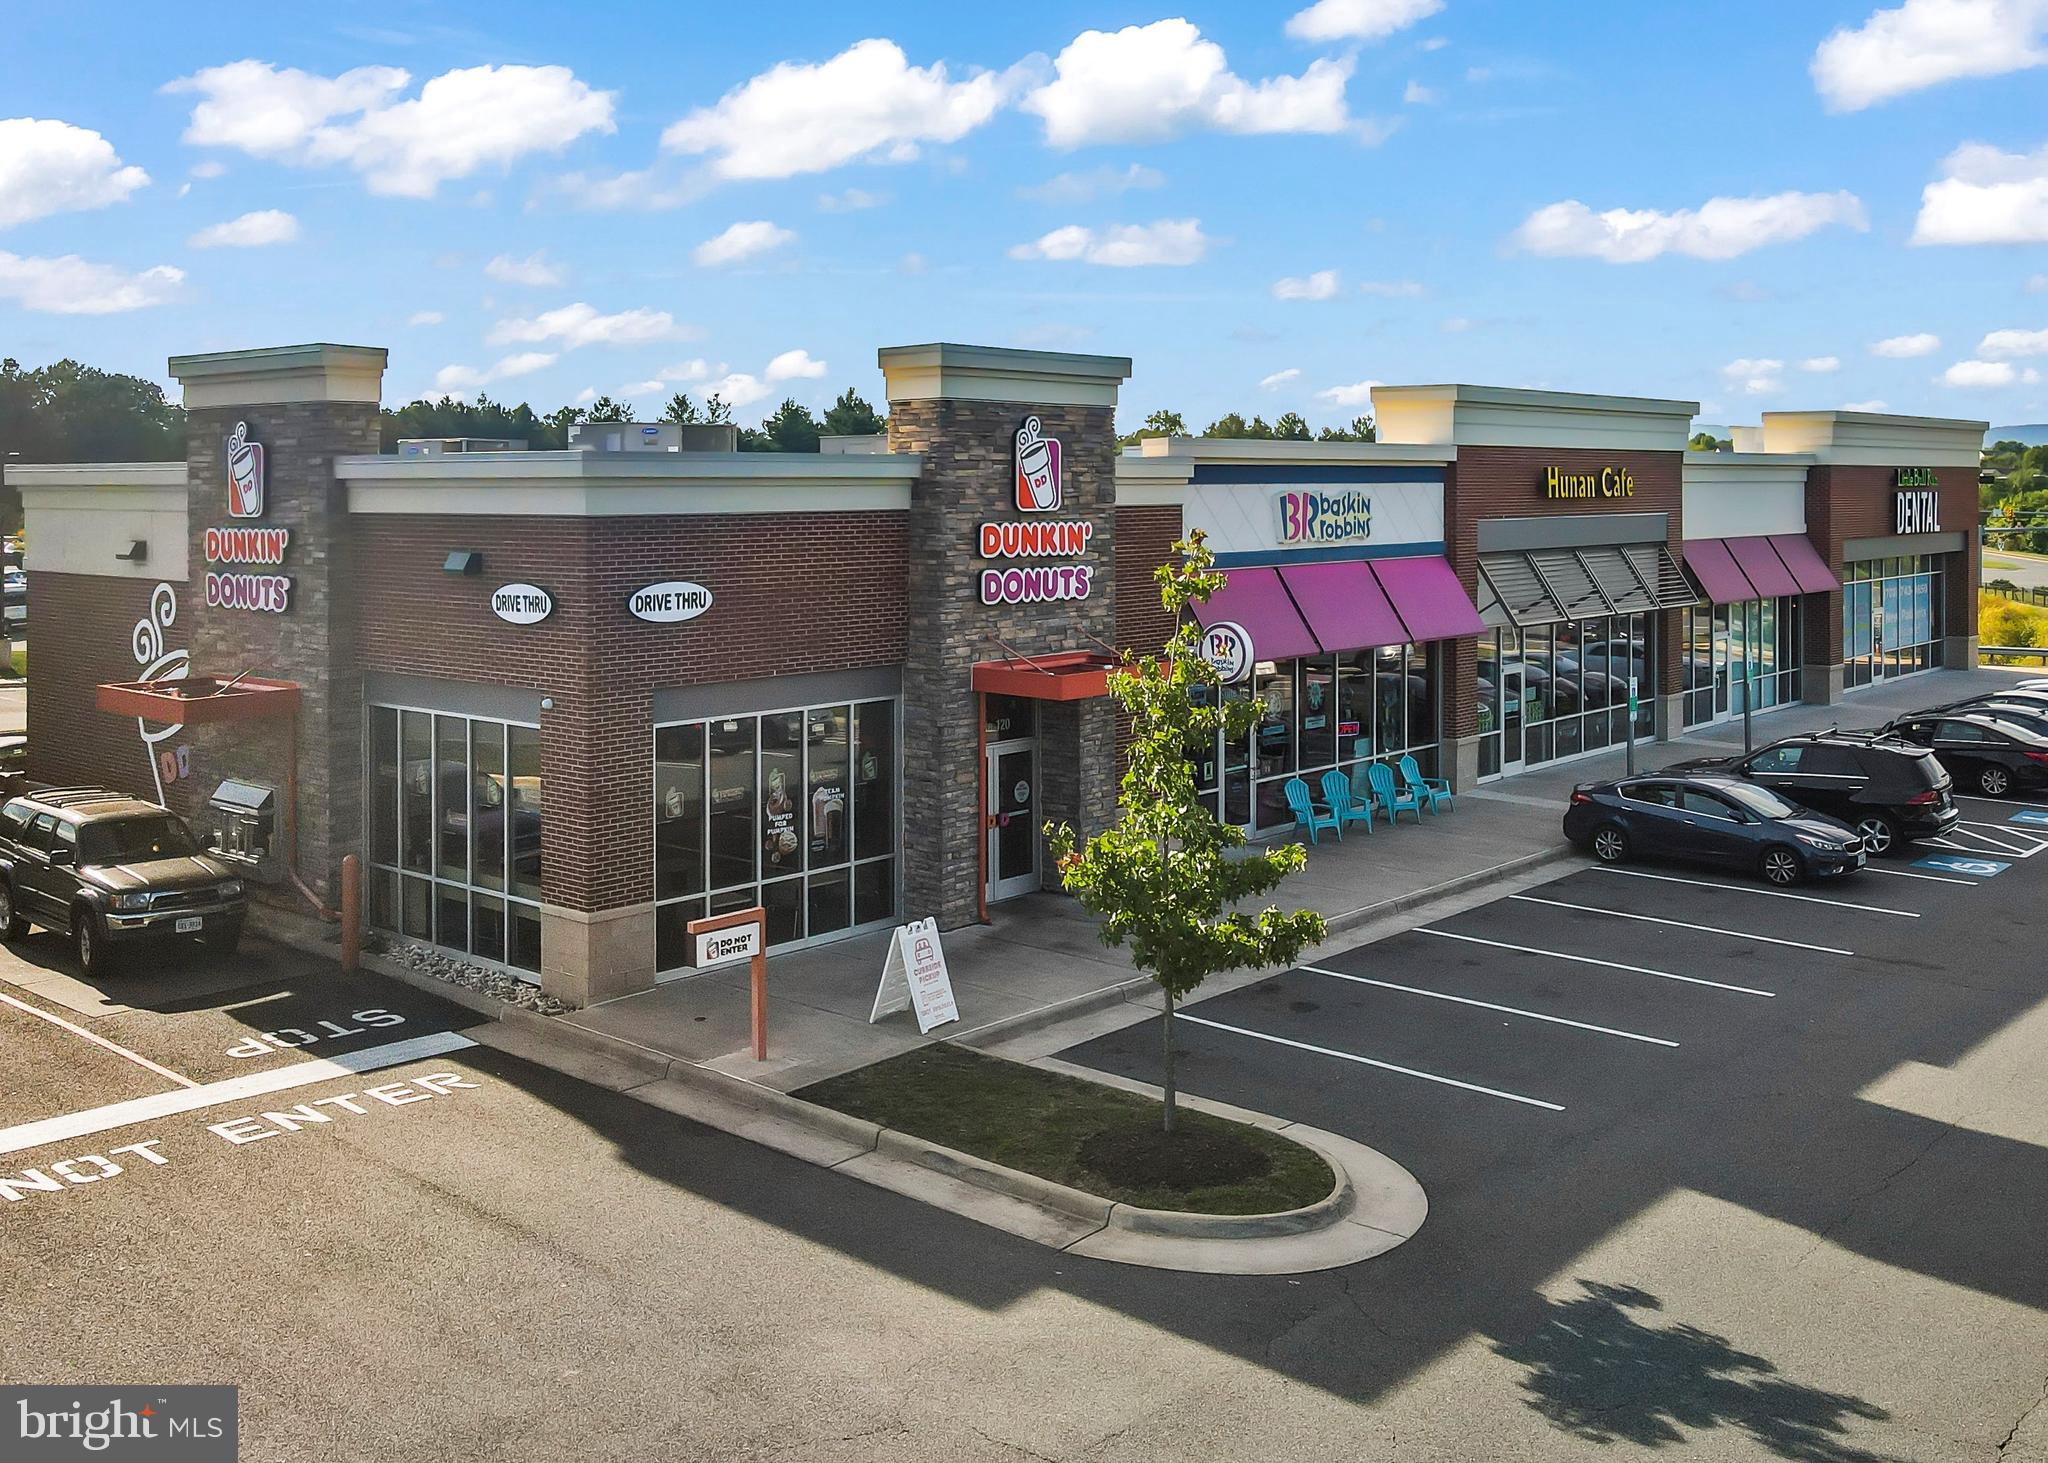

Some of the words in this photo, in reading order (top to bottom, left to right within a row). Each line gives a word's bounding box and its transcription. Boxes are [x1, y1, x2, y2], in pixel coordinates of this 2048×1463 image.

[1547, 466, 1596, 498] Hunan
[1601, 467, 1634, 497] Cafe
[1279, 492, 1319, 540] BR
[1320, 492, 1371, 516] baskin
[1896, 491, 1941, 534] DENTAL
[982, 523, 1091, 557] DUNKIN'
[1320, 516, 1371, 540] robbins
[207, 529, 288, 563] DUNKIN'
[207, 573, 288, 611] DONUTS
[983, 567, 1090, 603] DONUTS
[495, 594, 521, 612] DRIVE
[522, 595, 548, 613] THRU
[635, 593, 672, 613] DRIVE
[675, 591, 707, 610] THRU
[996, 718, 1011, 731] 120
[768, 813, 793, 822] PUMPED
[774, 820, 787, 828] FOR
[720, 938, 733, 948] DO
[734, 934, 752, 944] NOT
[720, 943, 748, 956] ENTER
[919, 970, 940, 984] PICKUP
[225, 1009, 407, 1058] STOP
[0, 1139, 169, 1202] NOT
[206, 1072, 481, 1145] ENTER
